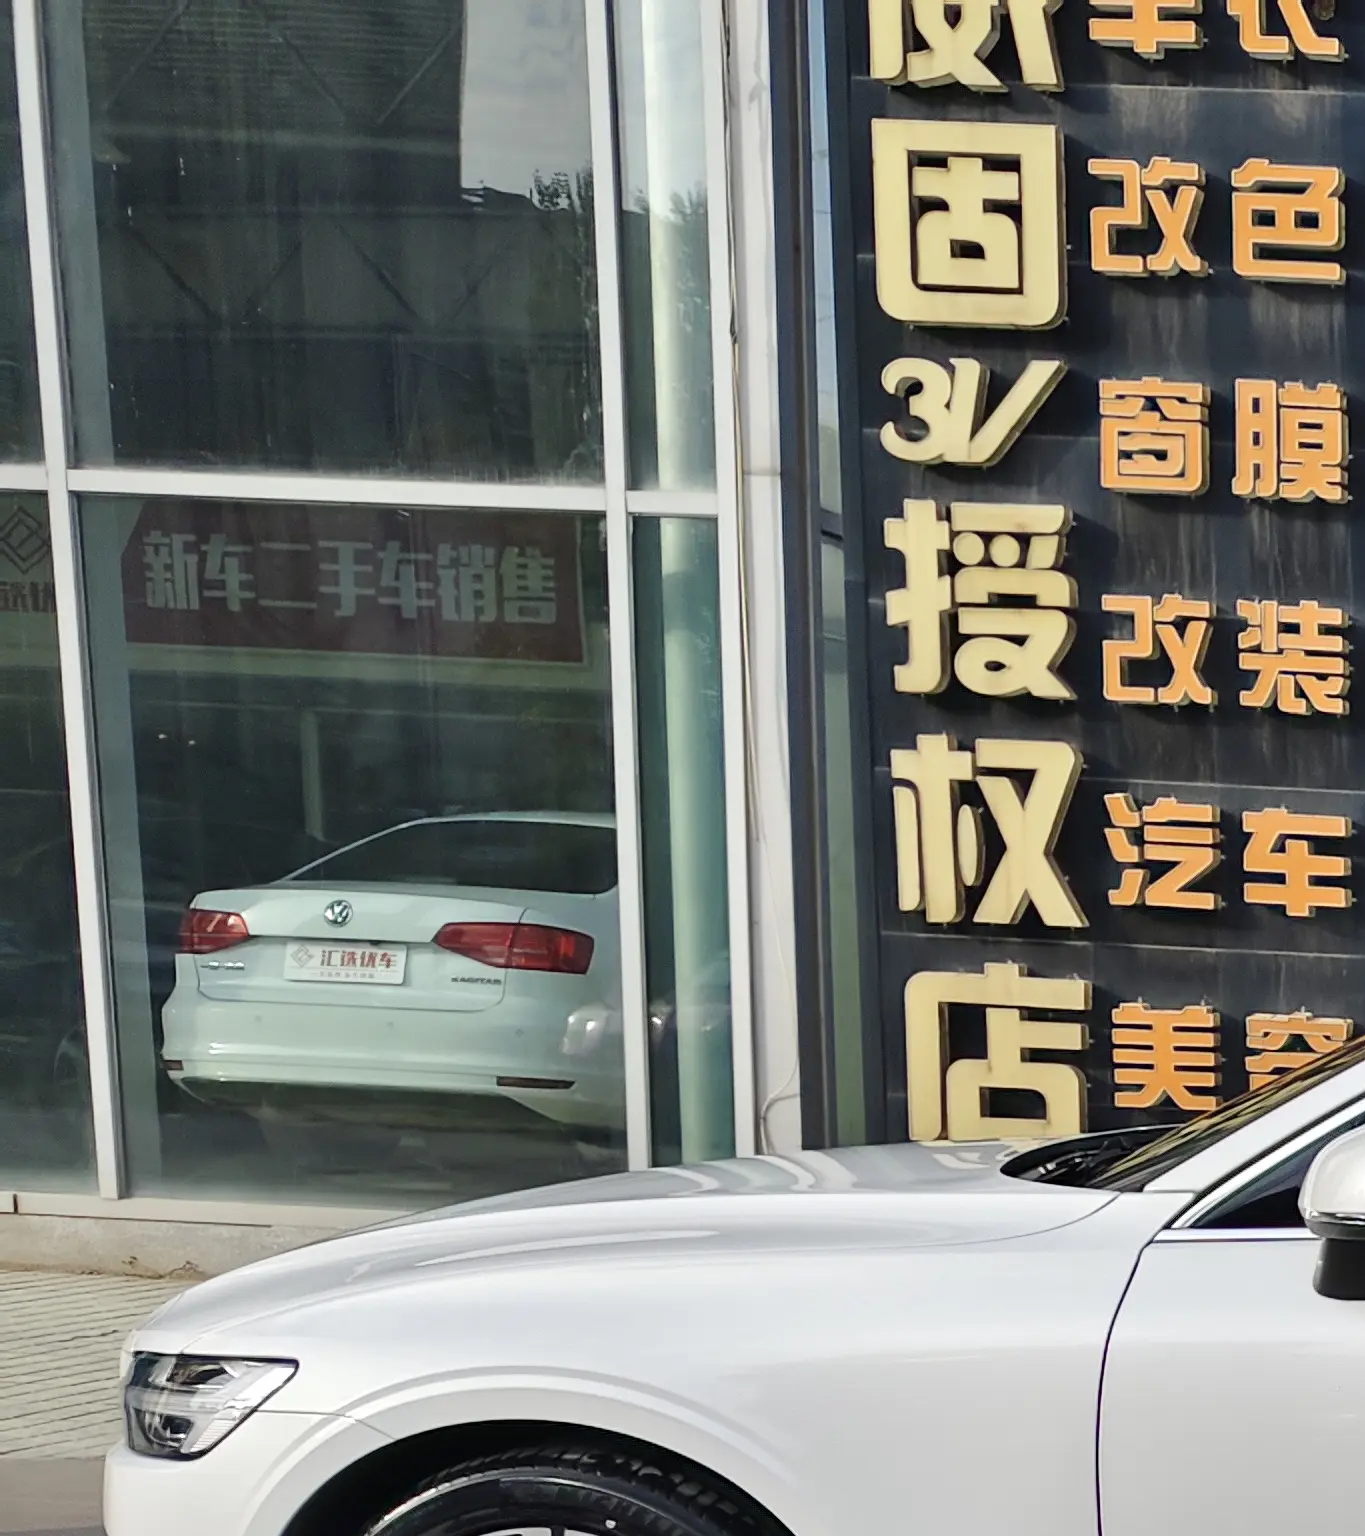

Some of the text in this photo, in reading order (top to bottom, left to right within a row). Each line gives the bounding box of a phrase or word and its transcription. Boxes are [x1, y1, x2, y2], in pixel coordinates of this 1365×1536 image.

[1087, 157, 1346, 285] 改色
[1099, 376, 1350, 502] 窗膜
[142, 528, 558, 625] 新车二手车销售
[1100, 592, 1350, 716] 改装
[1104, 791, 1352, 917] 汽车
